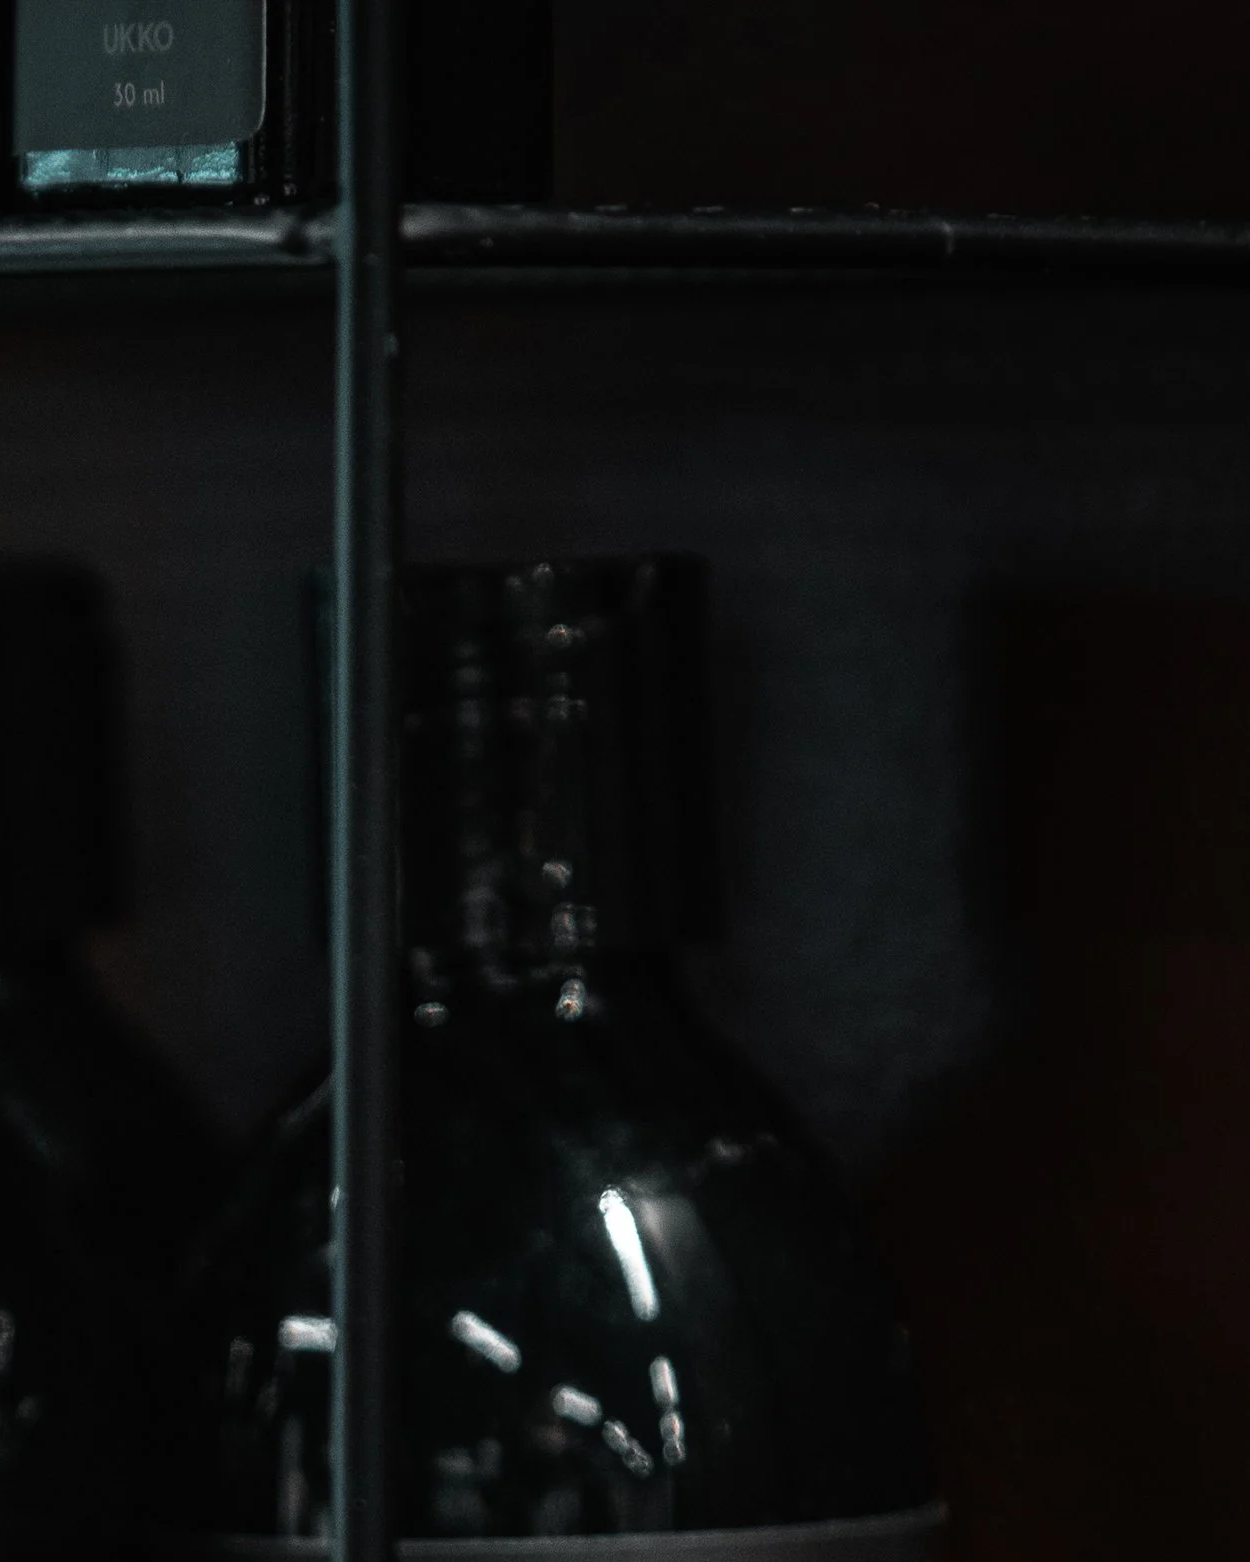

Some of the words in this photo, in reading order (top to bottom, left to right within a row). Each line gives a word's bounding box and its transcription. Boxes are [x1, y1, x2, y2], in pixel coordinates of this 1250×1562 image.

[103, 20, 174, 54] UKKO
[113, 81, 136, 107] 30
[143, 79, 165, 105] ml
